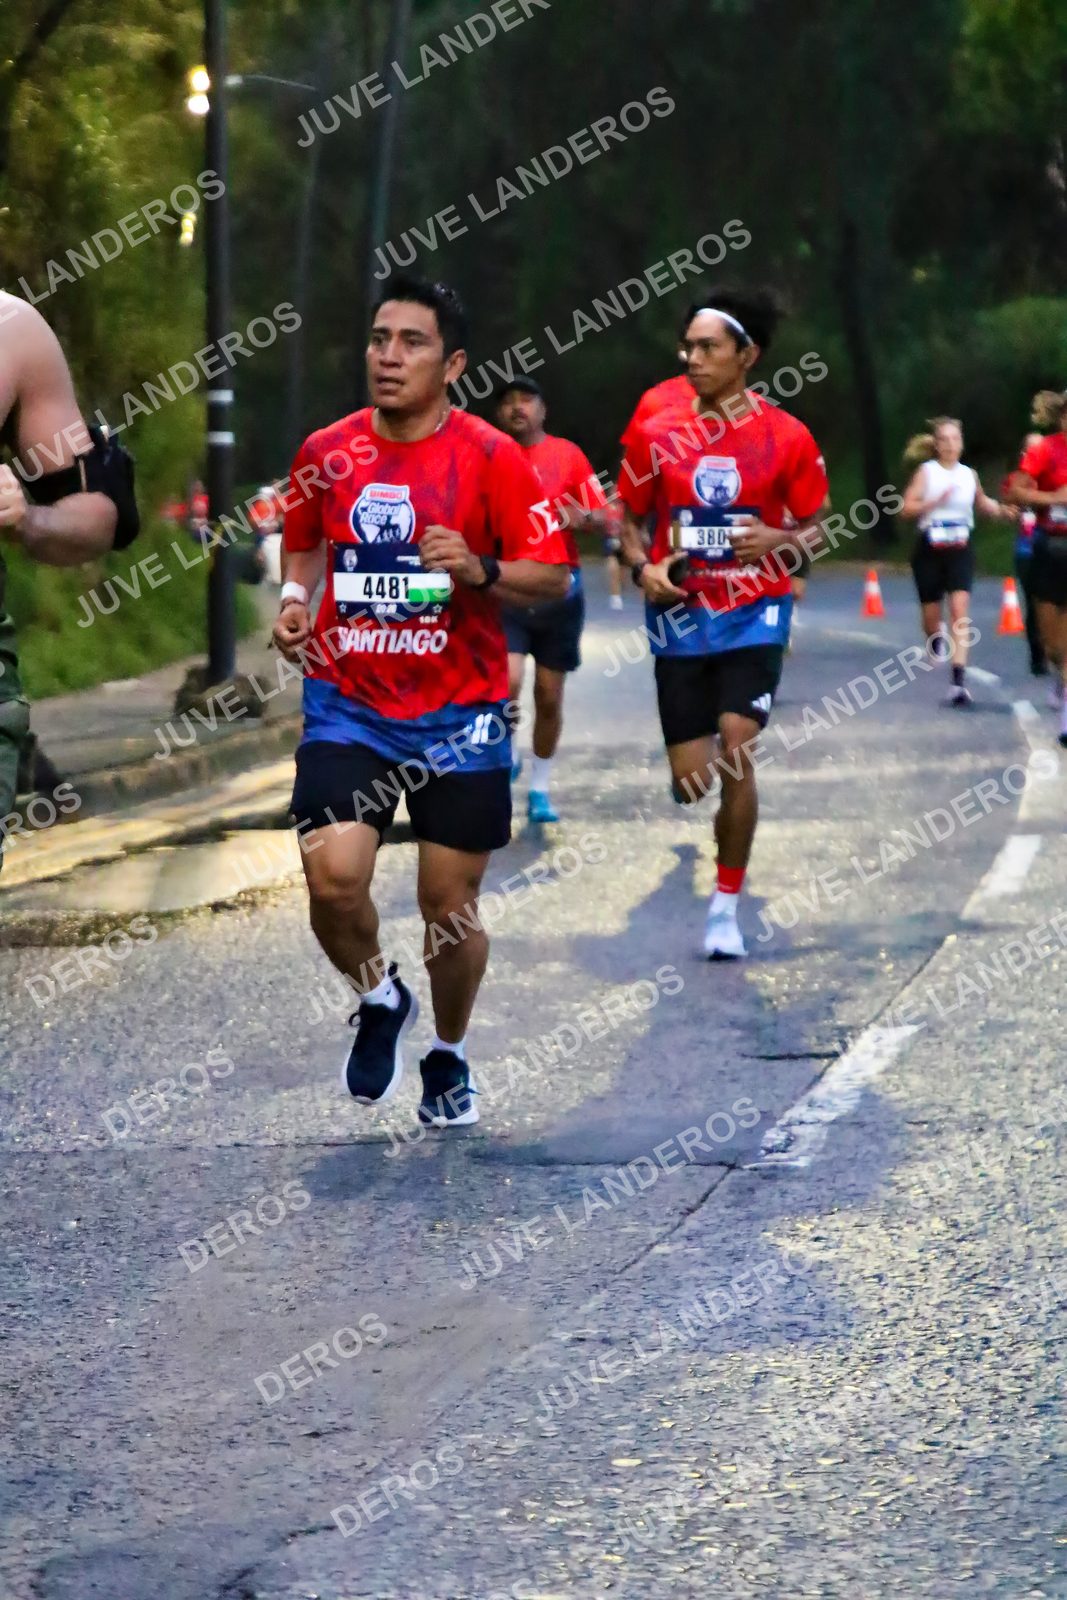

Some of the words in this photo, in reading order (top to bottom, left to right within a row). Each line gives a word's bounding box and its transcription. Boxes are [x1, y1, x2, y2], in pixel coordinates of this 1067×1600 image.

[367, 502, 400, 516] Global
[359, 513, 388, 525] Race
[697, 528, 732, 546] 380
[363, 576, 409, 600] 4481
[338, 626, 448, 655] SANTIAGO
